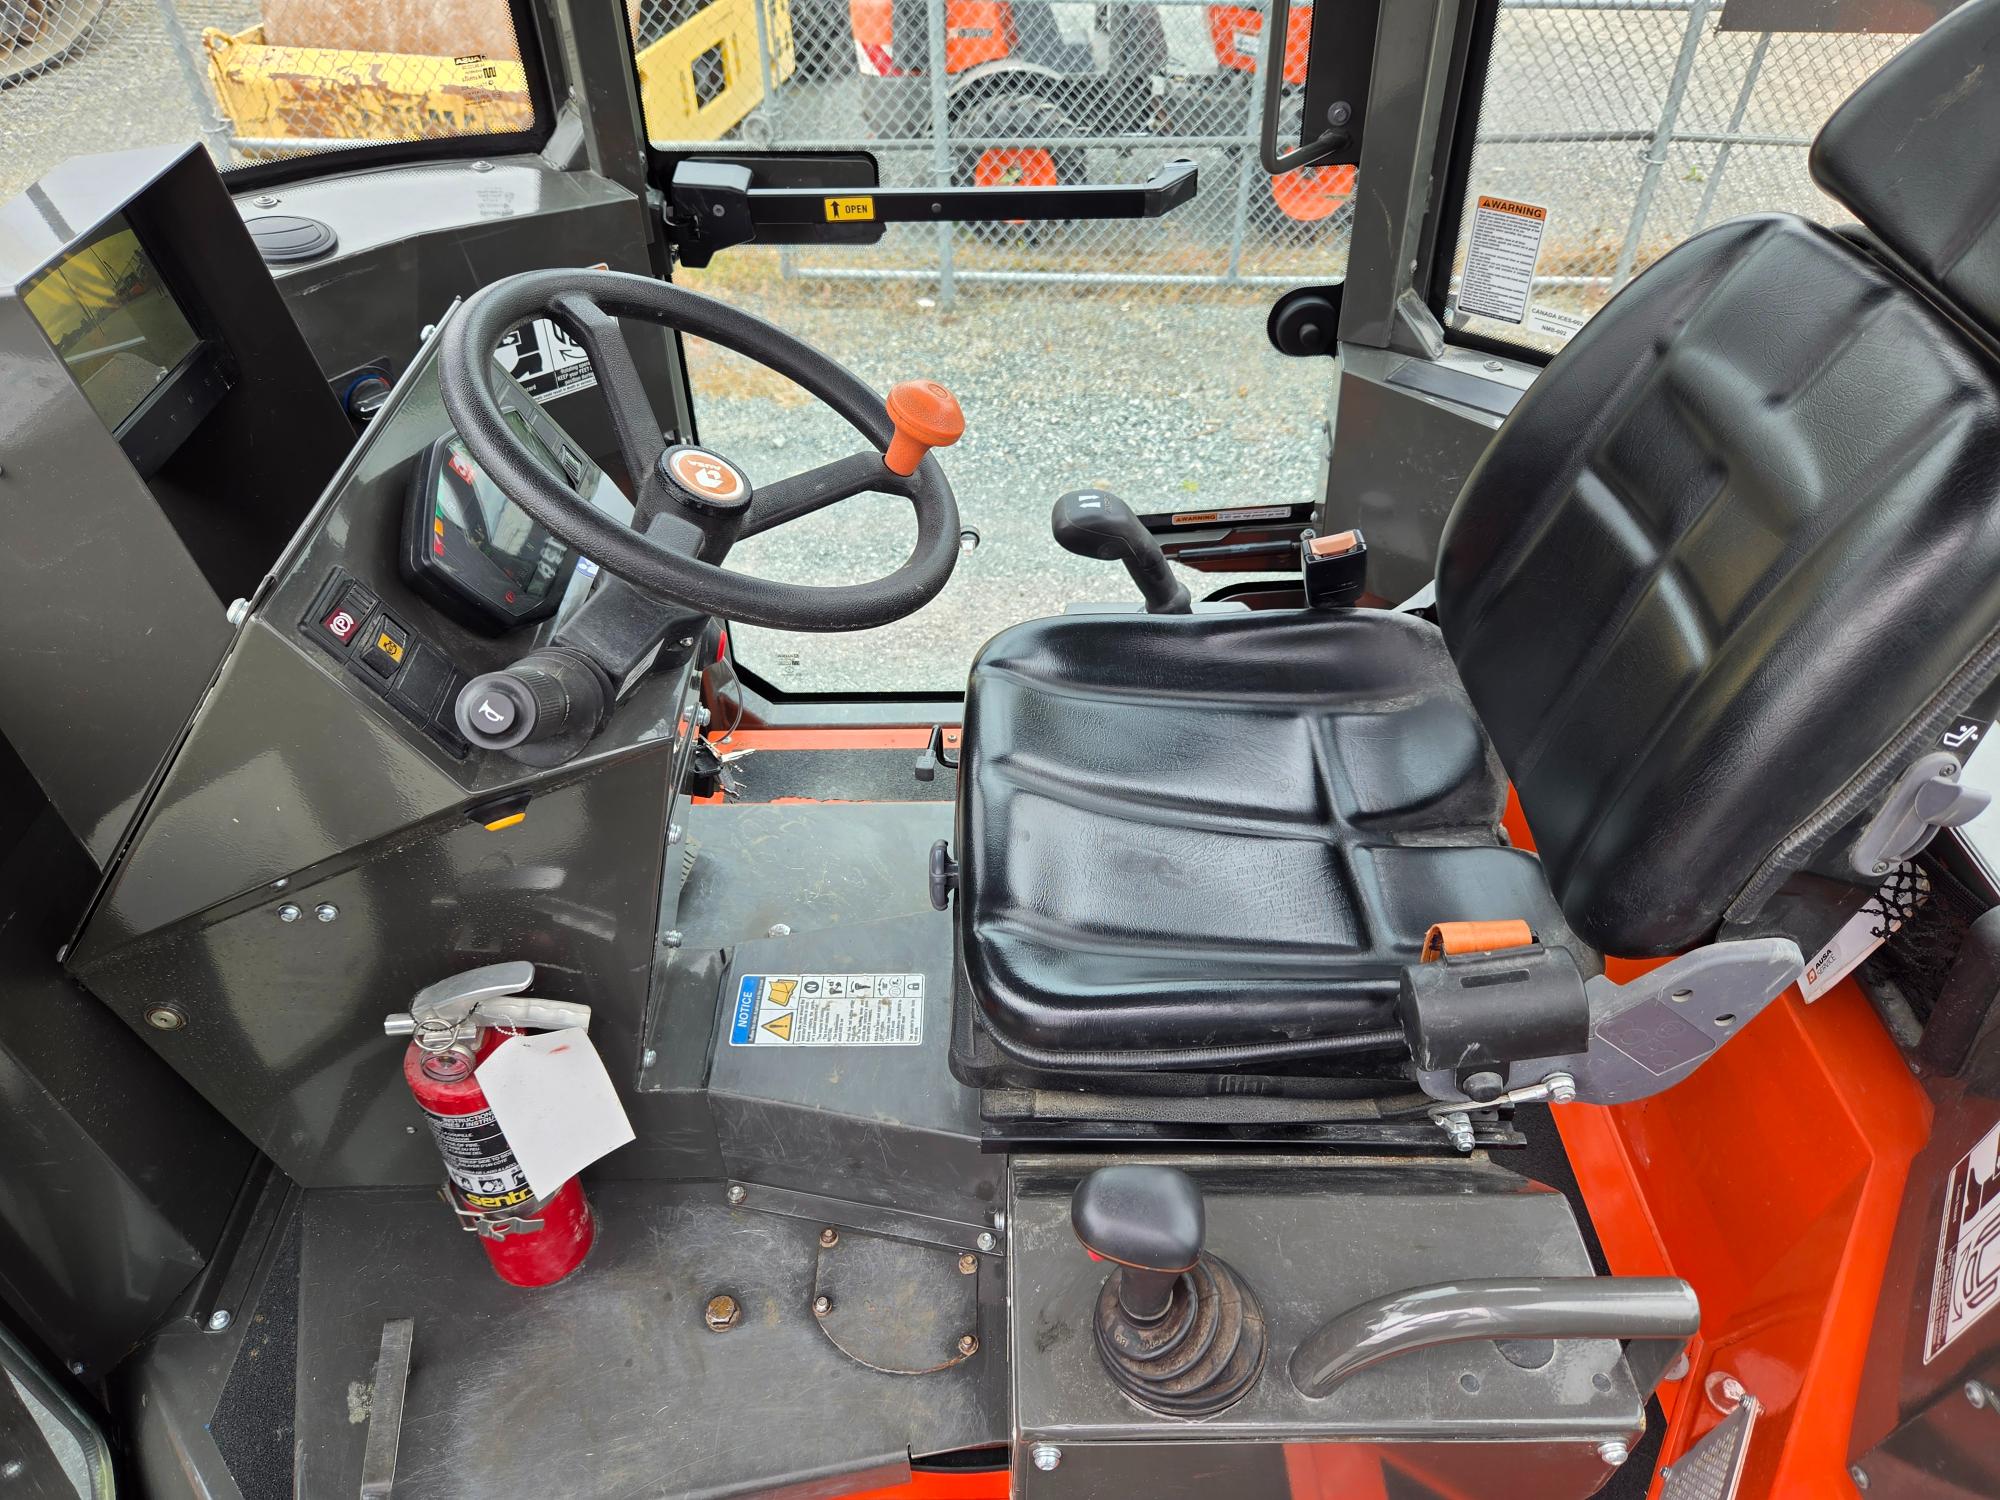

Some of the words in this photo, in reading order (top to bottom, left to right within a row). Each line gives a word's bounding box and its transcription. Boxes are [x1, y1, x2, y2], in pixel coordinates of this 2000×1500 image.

[845, 205, 868, 214] OPEN
[1491, 200, 1541, 218] WARNING
[1531, 307, 1557, 319] CANADA
[1181, 514, 1216, 522] WARNING
[1815, 949, 1832, 970] AUSA
[1817, 953, 1836, 975] SERVICE
[737, 991, 753, 1028] NOTICE
